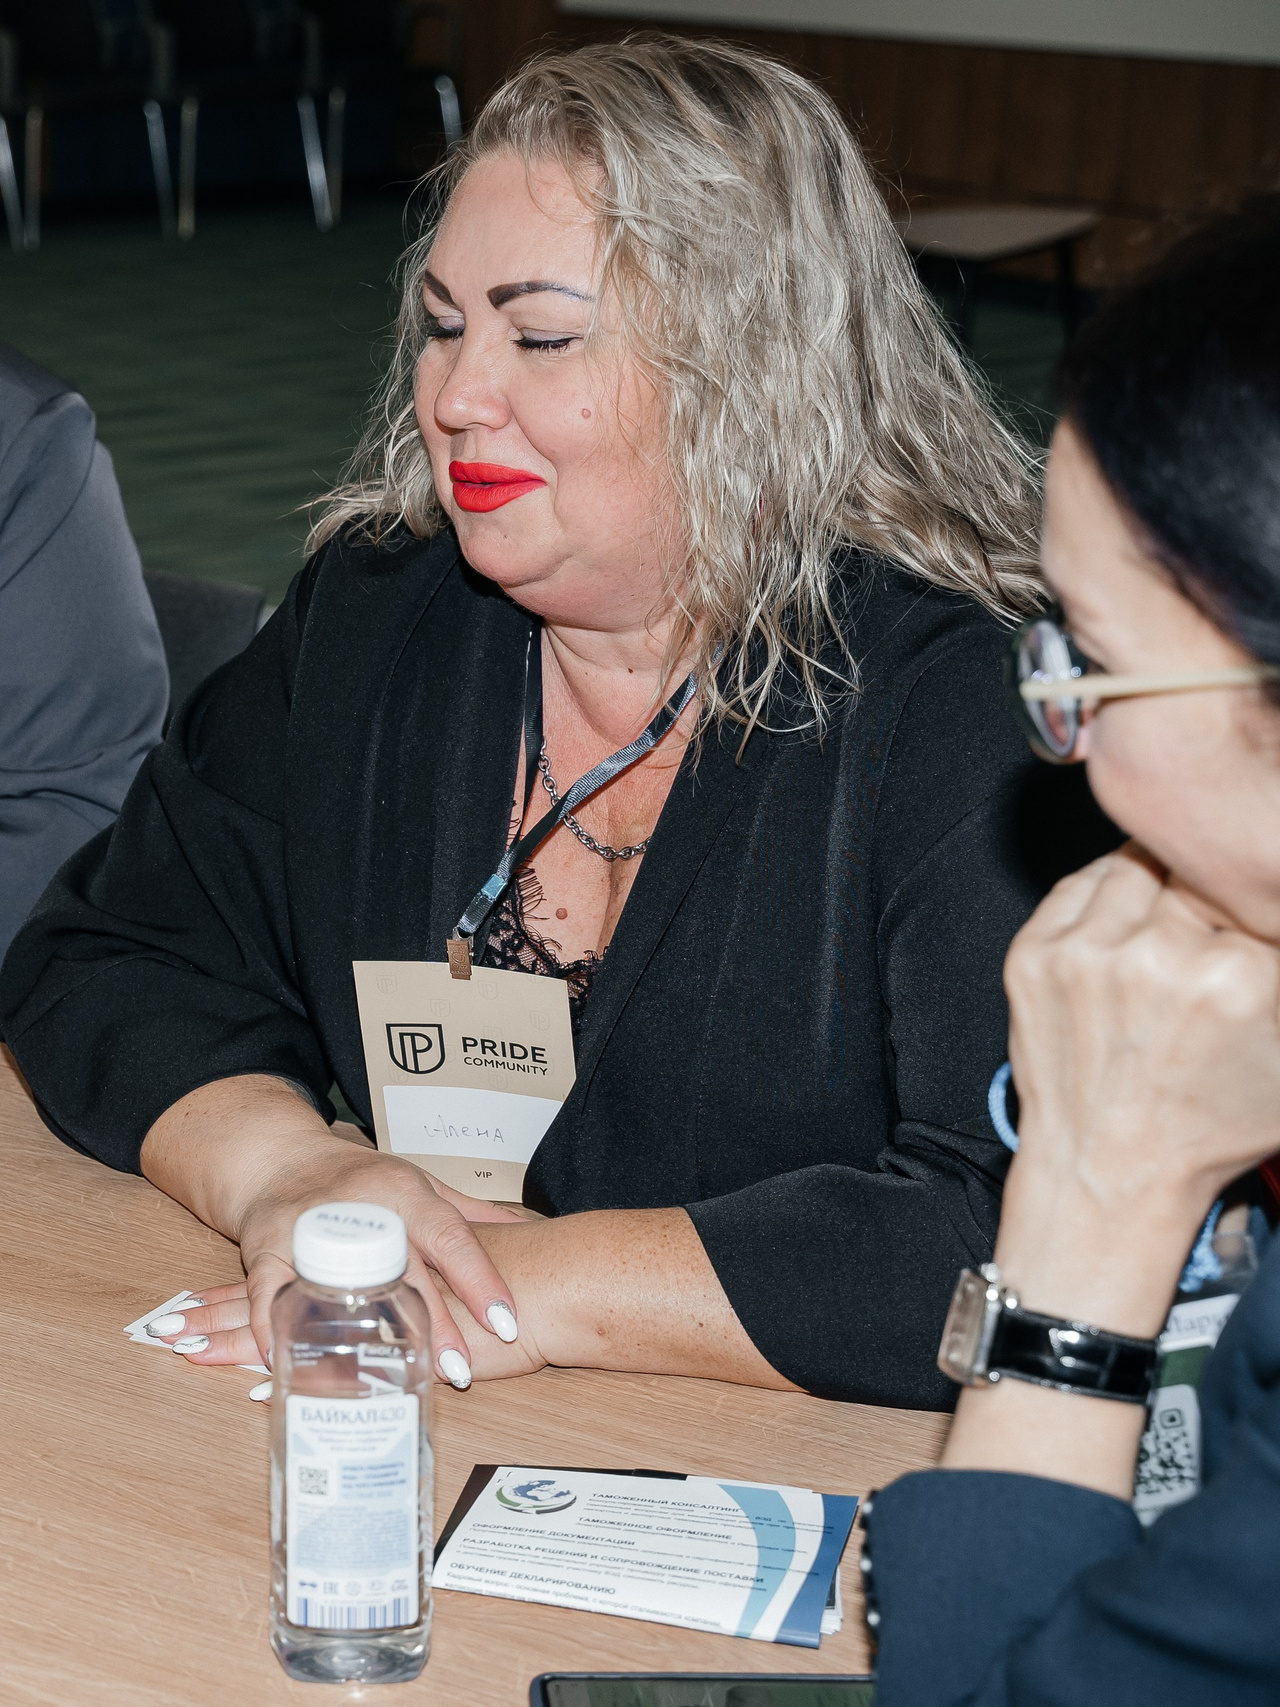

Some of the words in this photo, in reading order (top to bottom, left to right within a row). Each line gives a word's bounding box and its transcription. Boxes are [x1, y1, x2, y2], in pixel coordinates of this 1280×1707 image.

[461, 1036, 548, 1064] PRIDE
[463, 1056, 549, 1076] COMMUNITY
[474, 1170, 493, 1179] VIP
[592, 1493, 669, 1505] ТАМОЖЕННЫЙ
[671, 1501, 742, 1513] КОНСАЛТИНГ
[472, 1522, 546, 1535] ОФОРМЛЕНИЕ
[548, 1531, 635, 1545] ДОКУМЕНТАЦИИ
[578, 1517, 653, 1530] ТАМОЖЕННОЕ
[656, 1526, 733, 1540] ОФОРМЛЕНИЕ
[463, 1538, 531, 1551] РАЗРАБОТКА
[534, 1547, 587, 1558] РЕШЕНИЙ
[601, 1555, 700, 1574] СОПРОВОЖДЕНИЕ
[704, 1569, 764, 1584] ПОСТАВКИ
[450, 1562, 508, 1576] ОБУЧЕНИЕ
[509, 1571, 616, 1595] ДЕКЛАРИРОВАНИЮ
